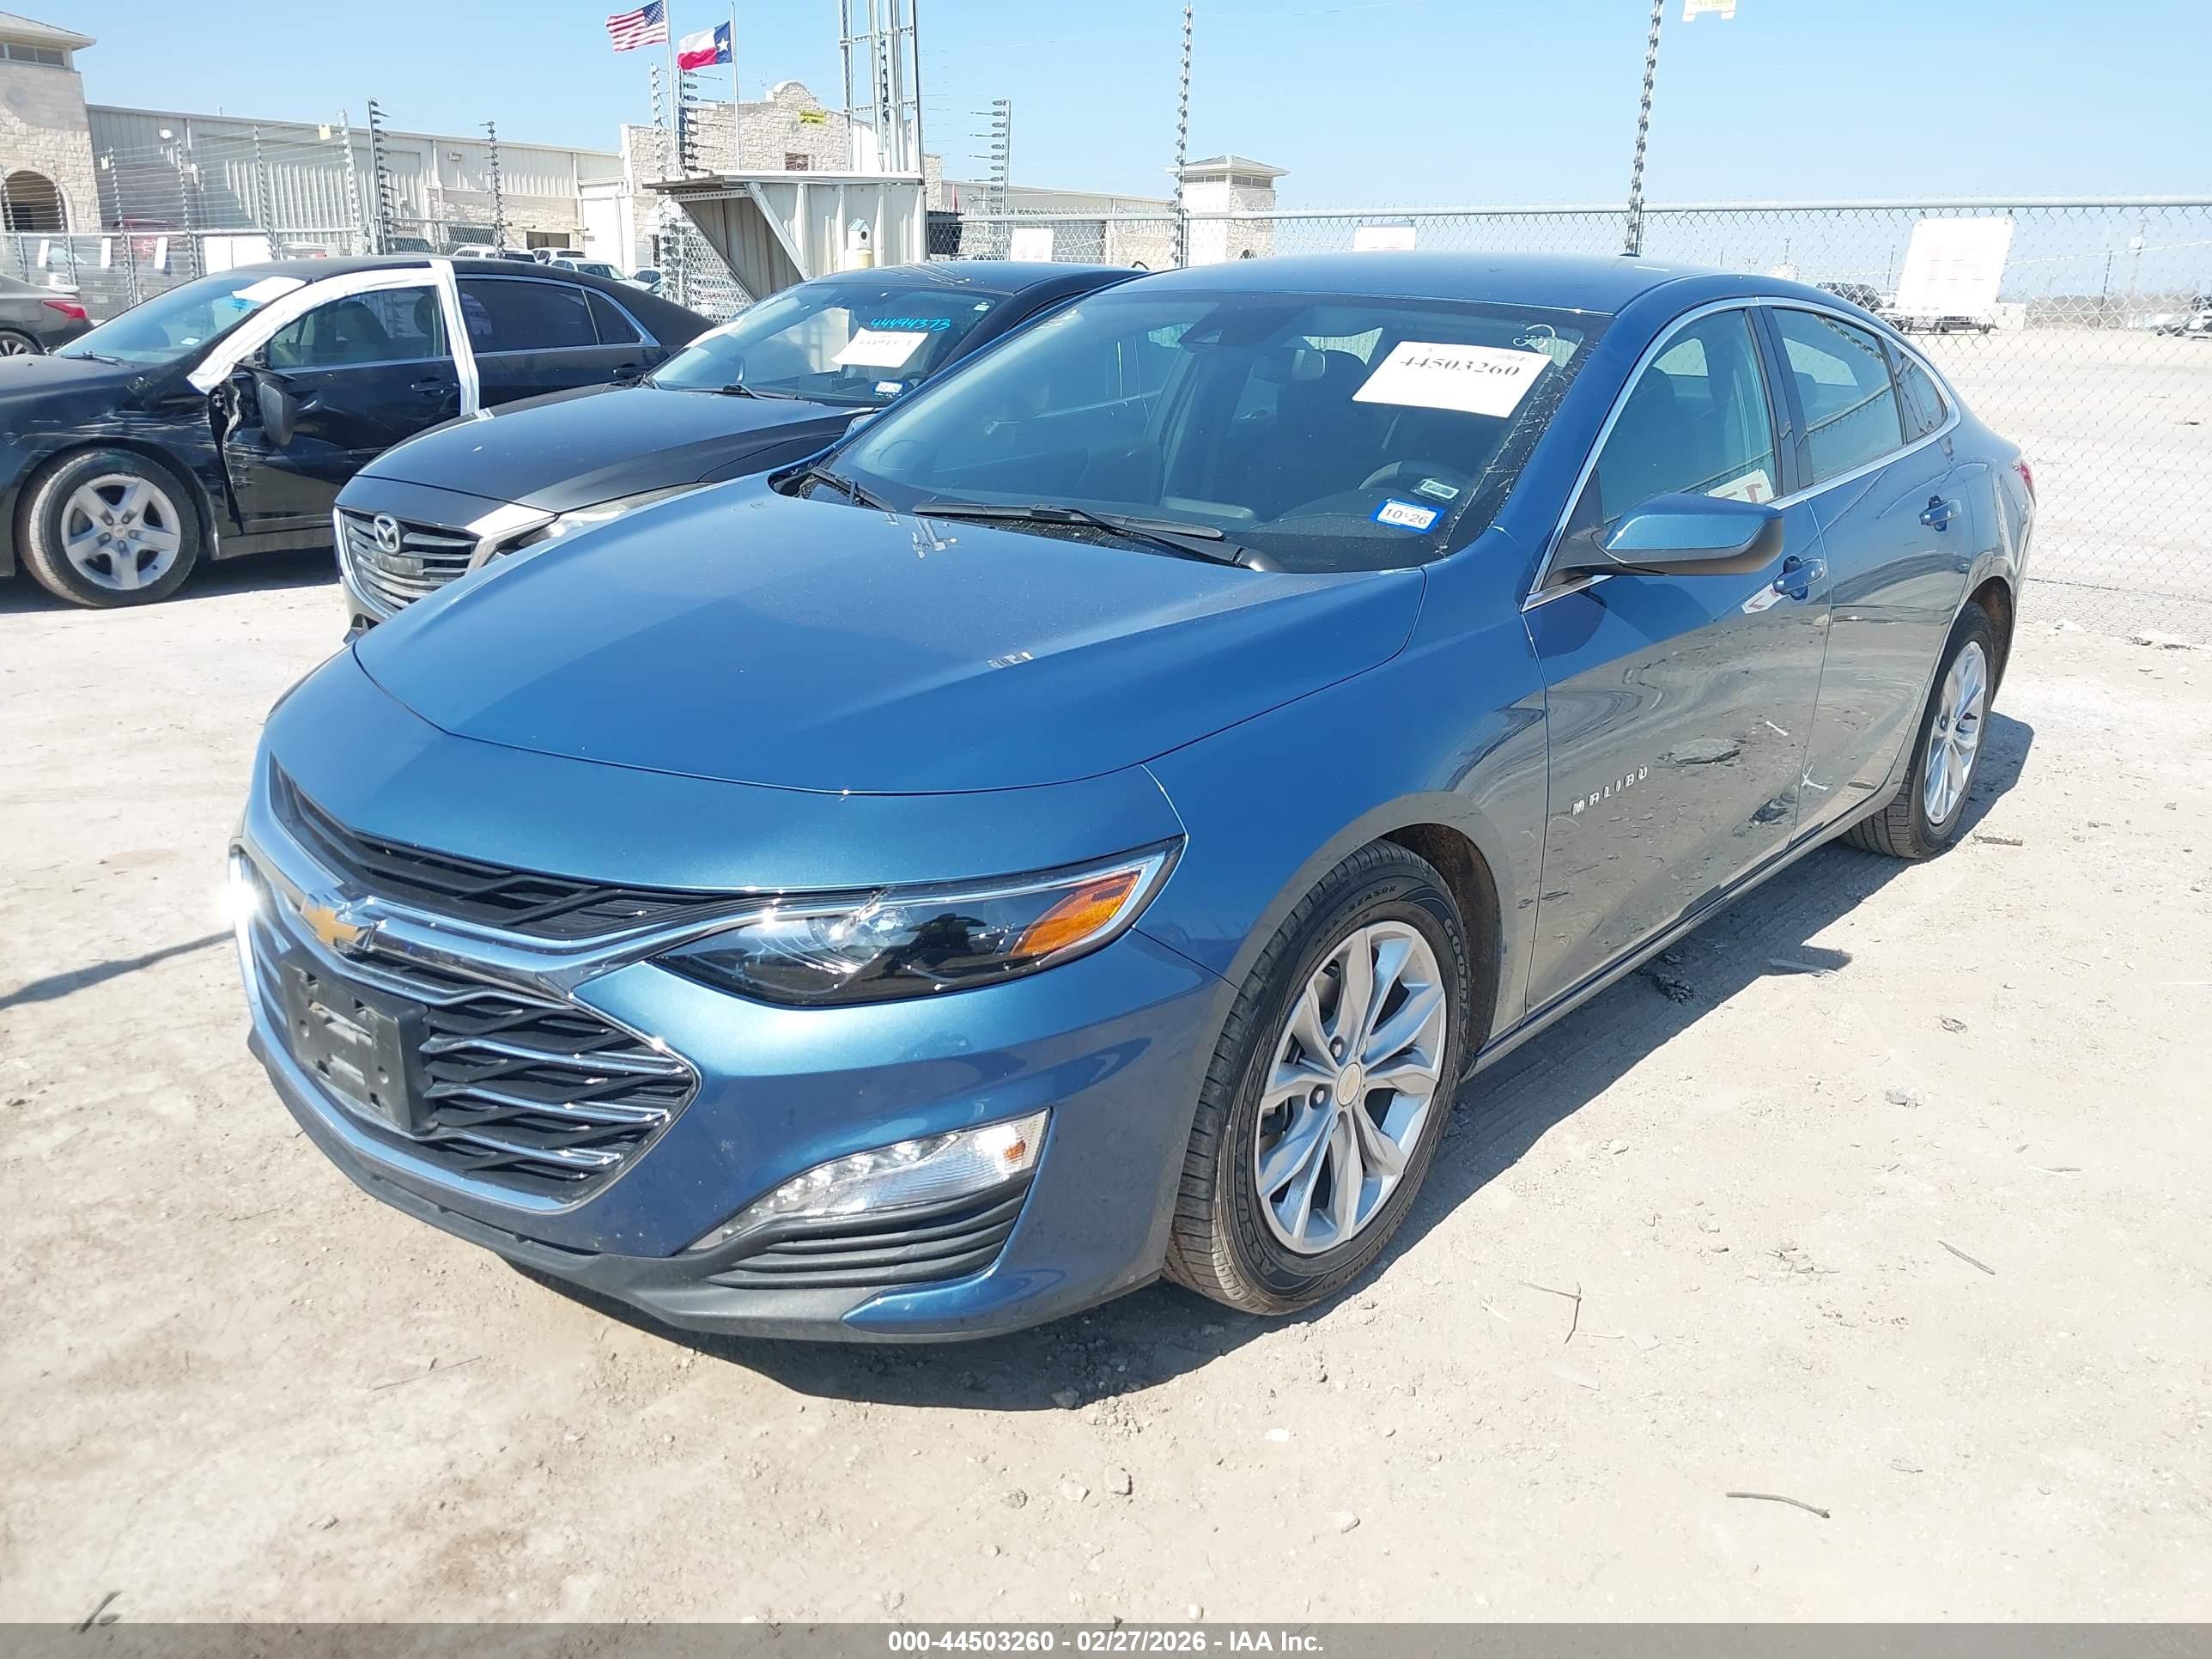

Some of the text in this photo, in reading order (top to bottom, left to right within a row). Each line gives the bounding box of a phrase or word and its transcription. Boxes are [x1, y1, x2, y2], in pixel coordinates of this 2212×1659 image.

[870, 317, 951, 331] 44494373
[1400, 356, 1520, 376] 44503260
[1571, 765, 1648, 816] MALIBU
